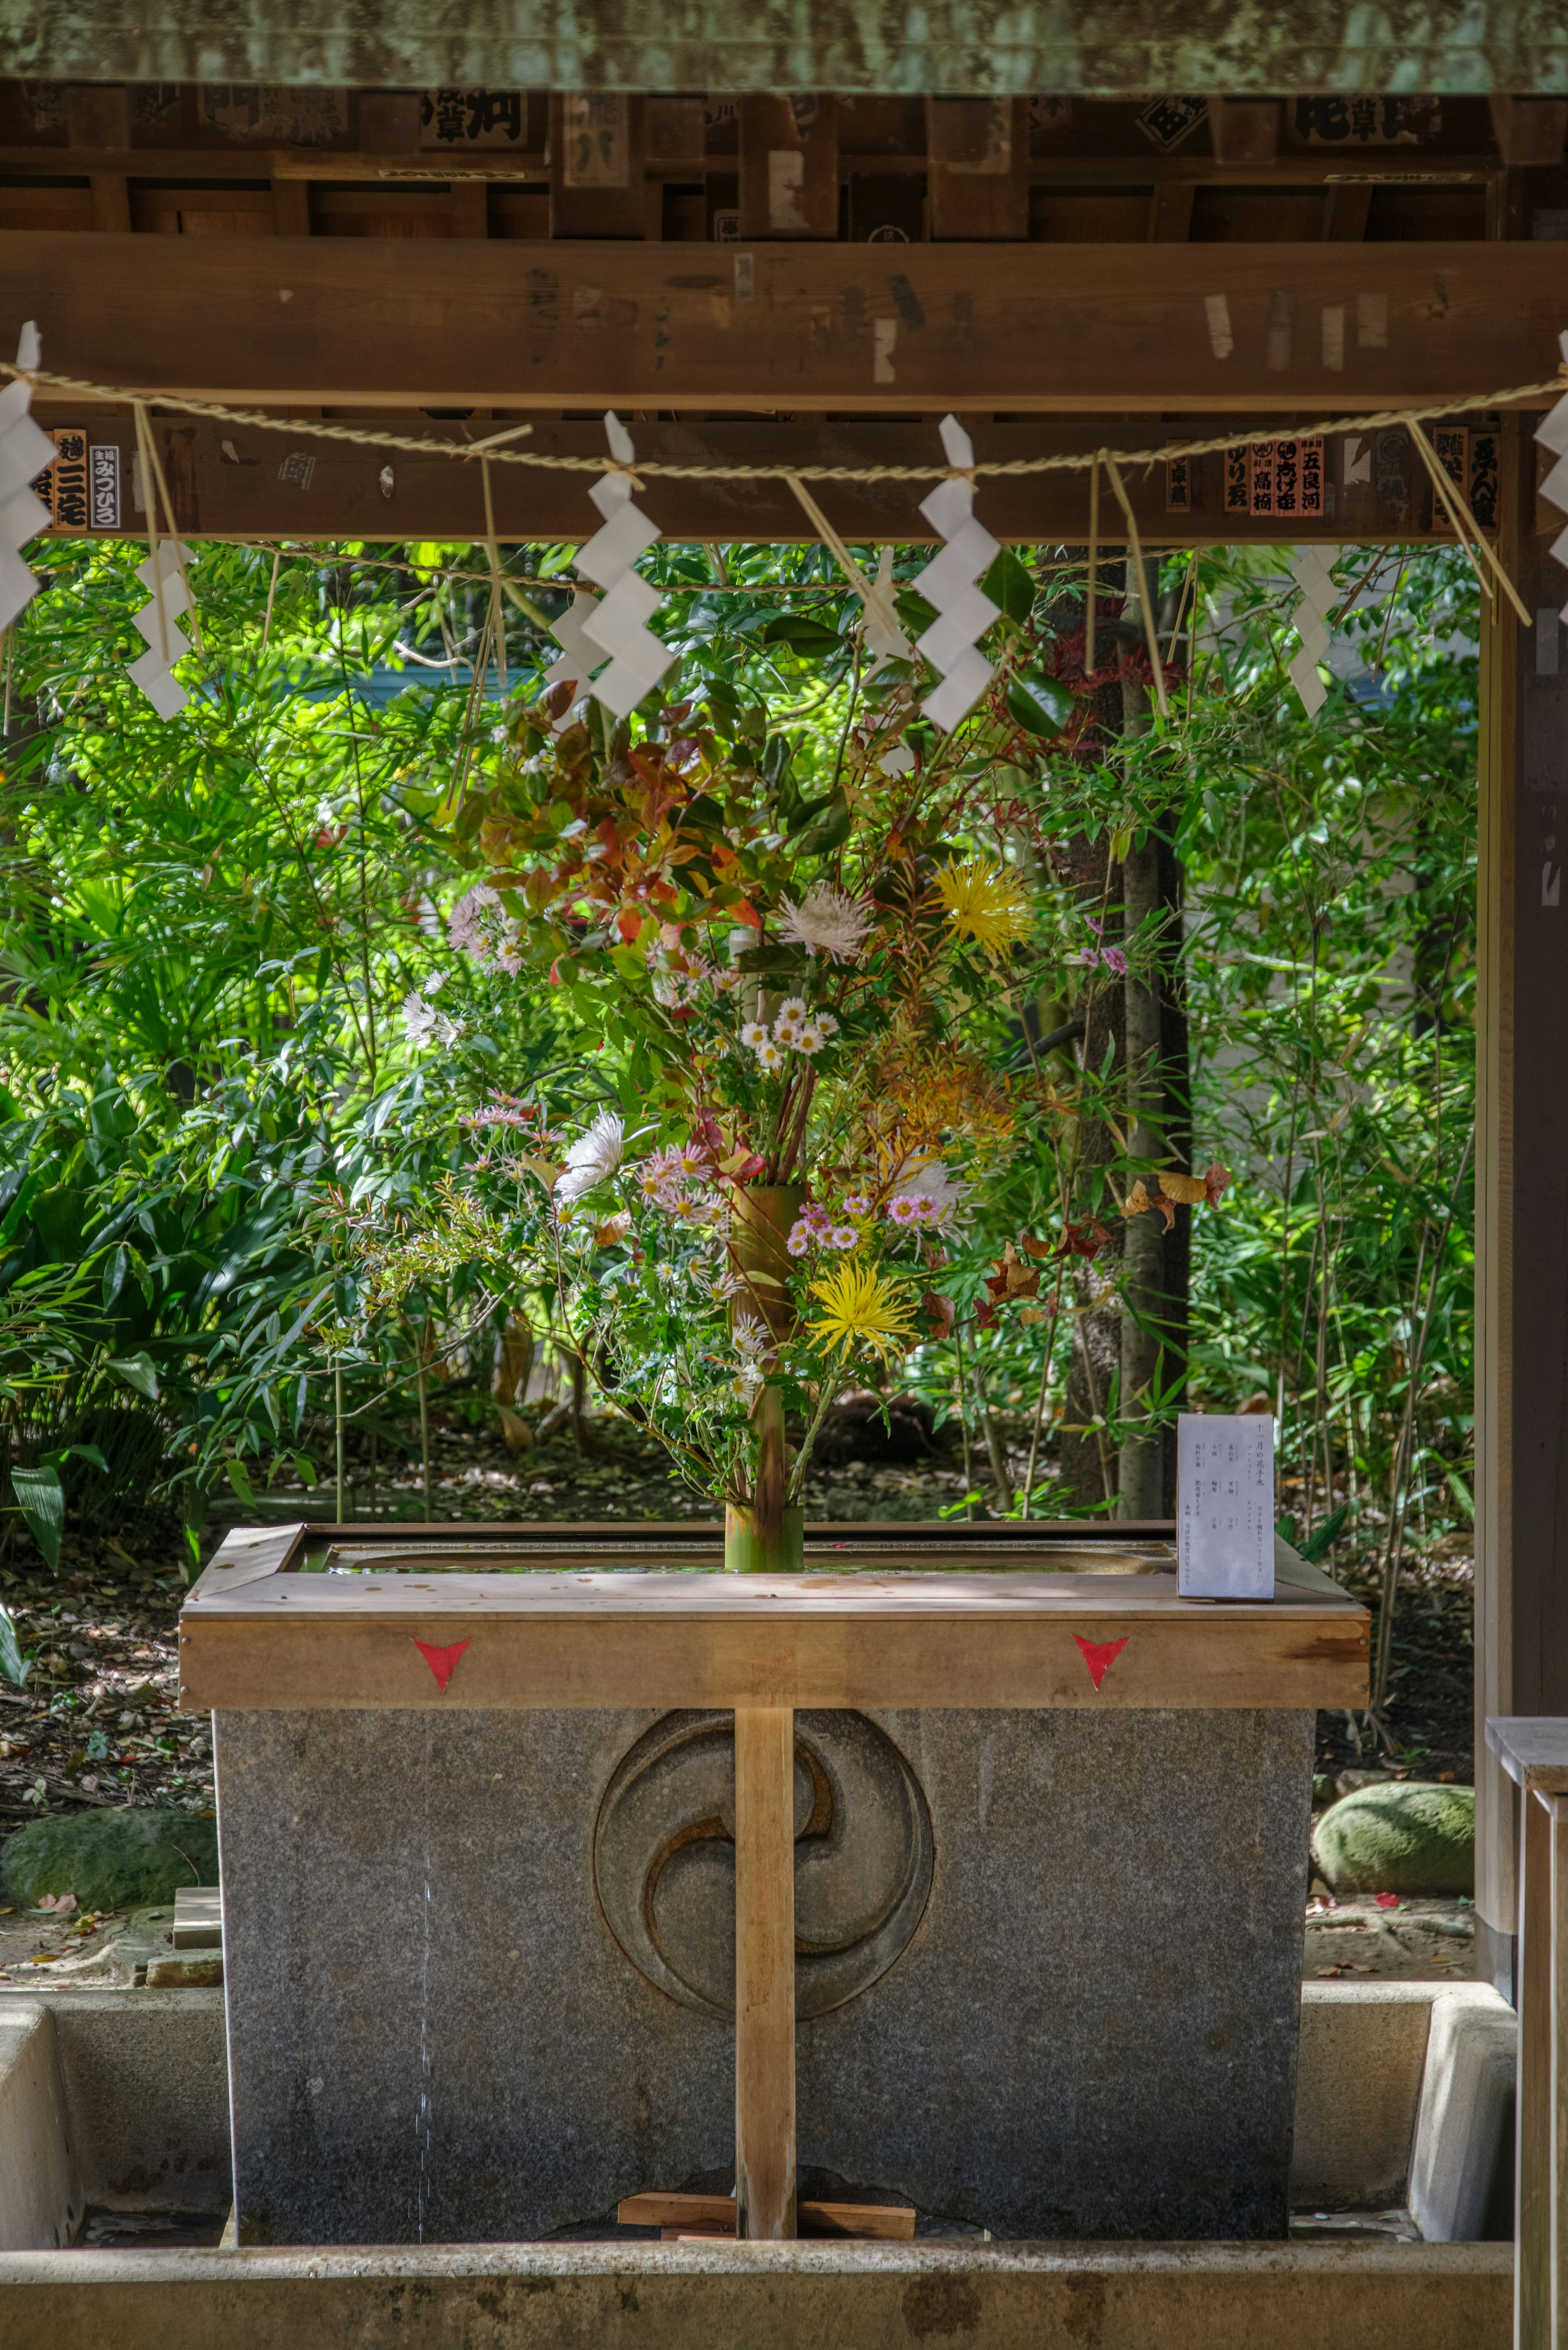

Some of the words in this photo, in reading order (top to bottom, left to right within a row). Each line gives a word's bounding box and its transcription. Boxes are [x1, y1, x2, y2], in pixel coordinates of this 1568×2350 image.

[56, 463, 86, 526] 三宅
[95, 460, 115, 523] みつひろ
[1255, 1422, 1265, 1487] 十一月の花手水
[1185, 1504, 1191, 1516] 奉納
